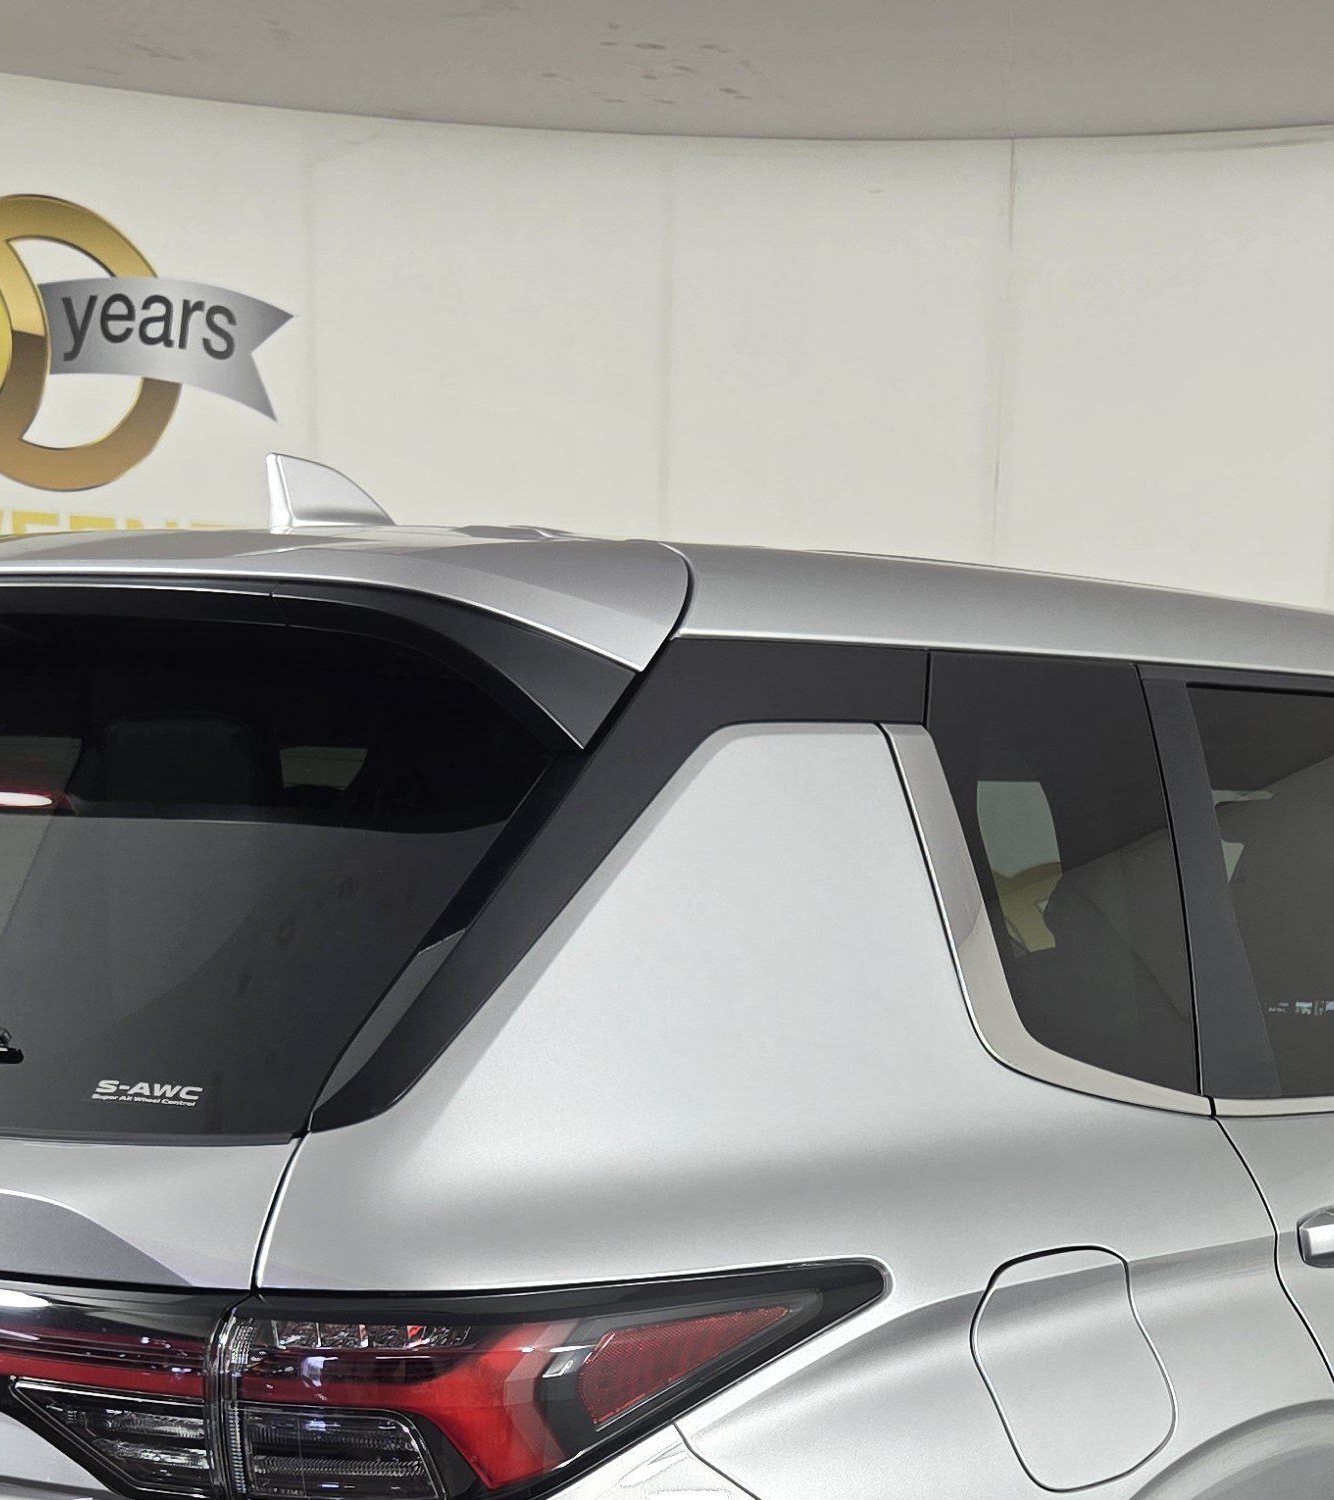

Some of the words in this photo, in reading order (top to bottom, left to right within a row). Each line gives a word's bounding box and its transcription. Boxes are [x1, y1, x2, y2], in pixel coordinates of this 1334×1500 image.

[60, 291, 238, 362] years
[91, 1093, 119, 1101] Super
[161, 1098, 196, 1107] Control
[95, 1079, 204, 1100] S-AWC
